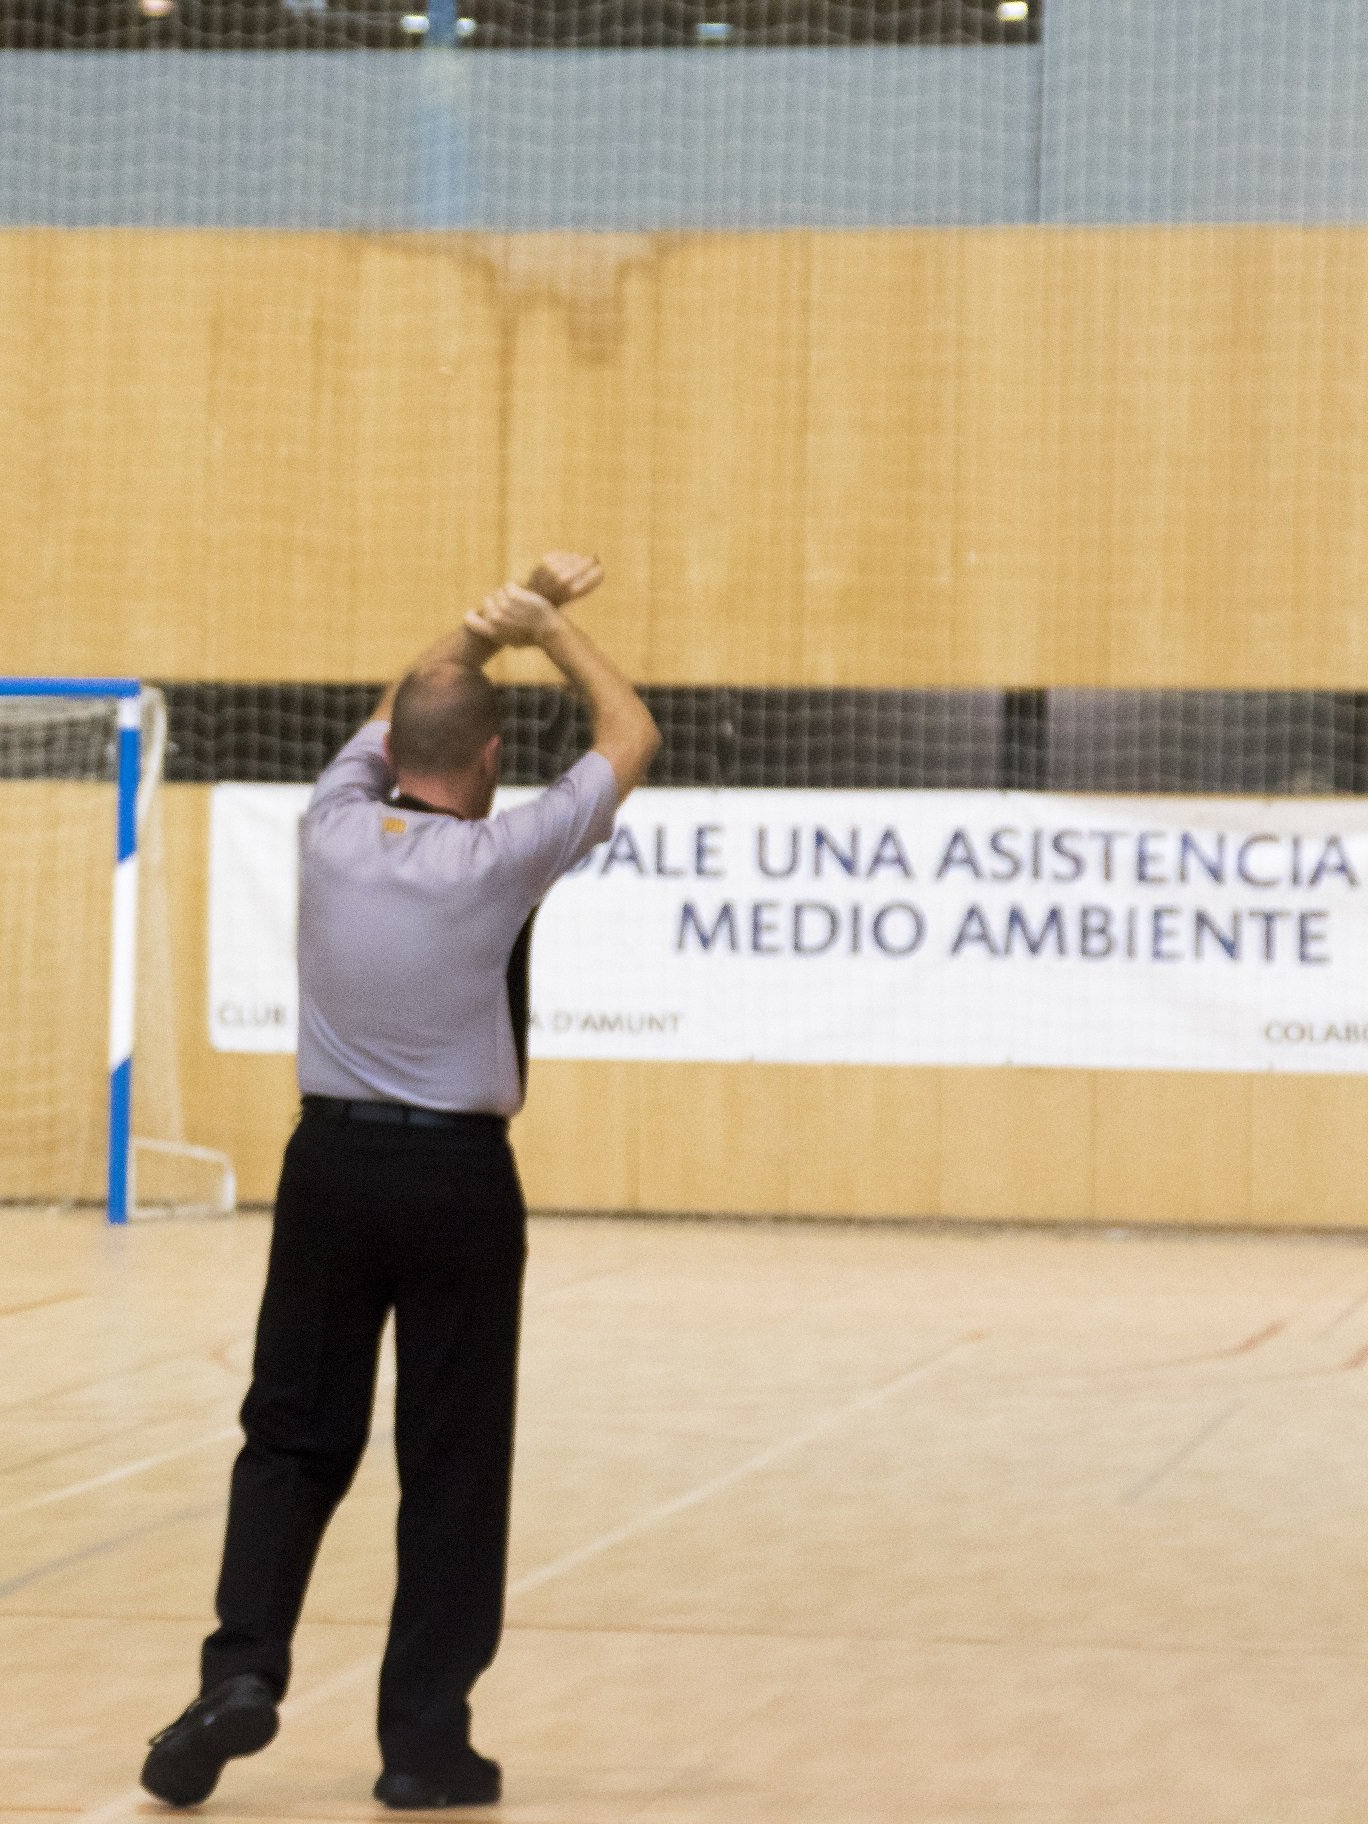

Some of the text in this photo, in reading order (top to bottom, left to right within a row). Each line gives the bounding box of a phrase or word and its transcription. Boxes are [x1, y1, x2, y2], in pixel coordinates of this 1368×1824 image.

[568, 823, 1359, 888] ALE UNA ASISTENCIA
[677, 900, 1332, 965] MEDIO AMBIENTE
[216, 1003, 285, 1028] CLUB
